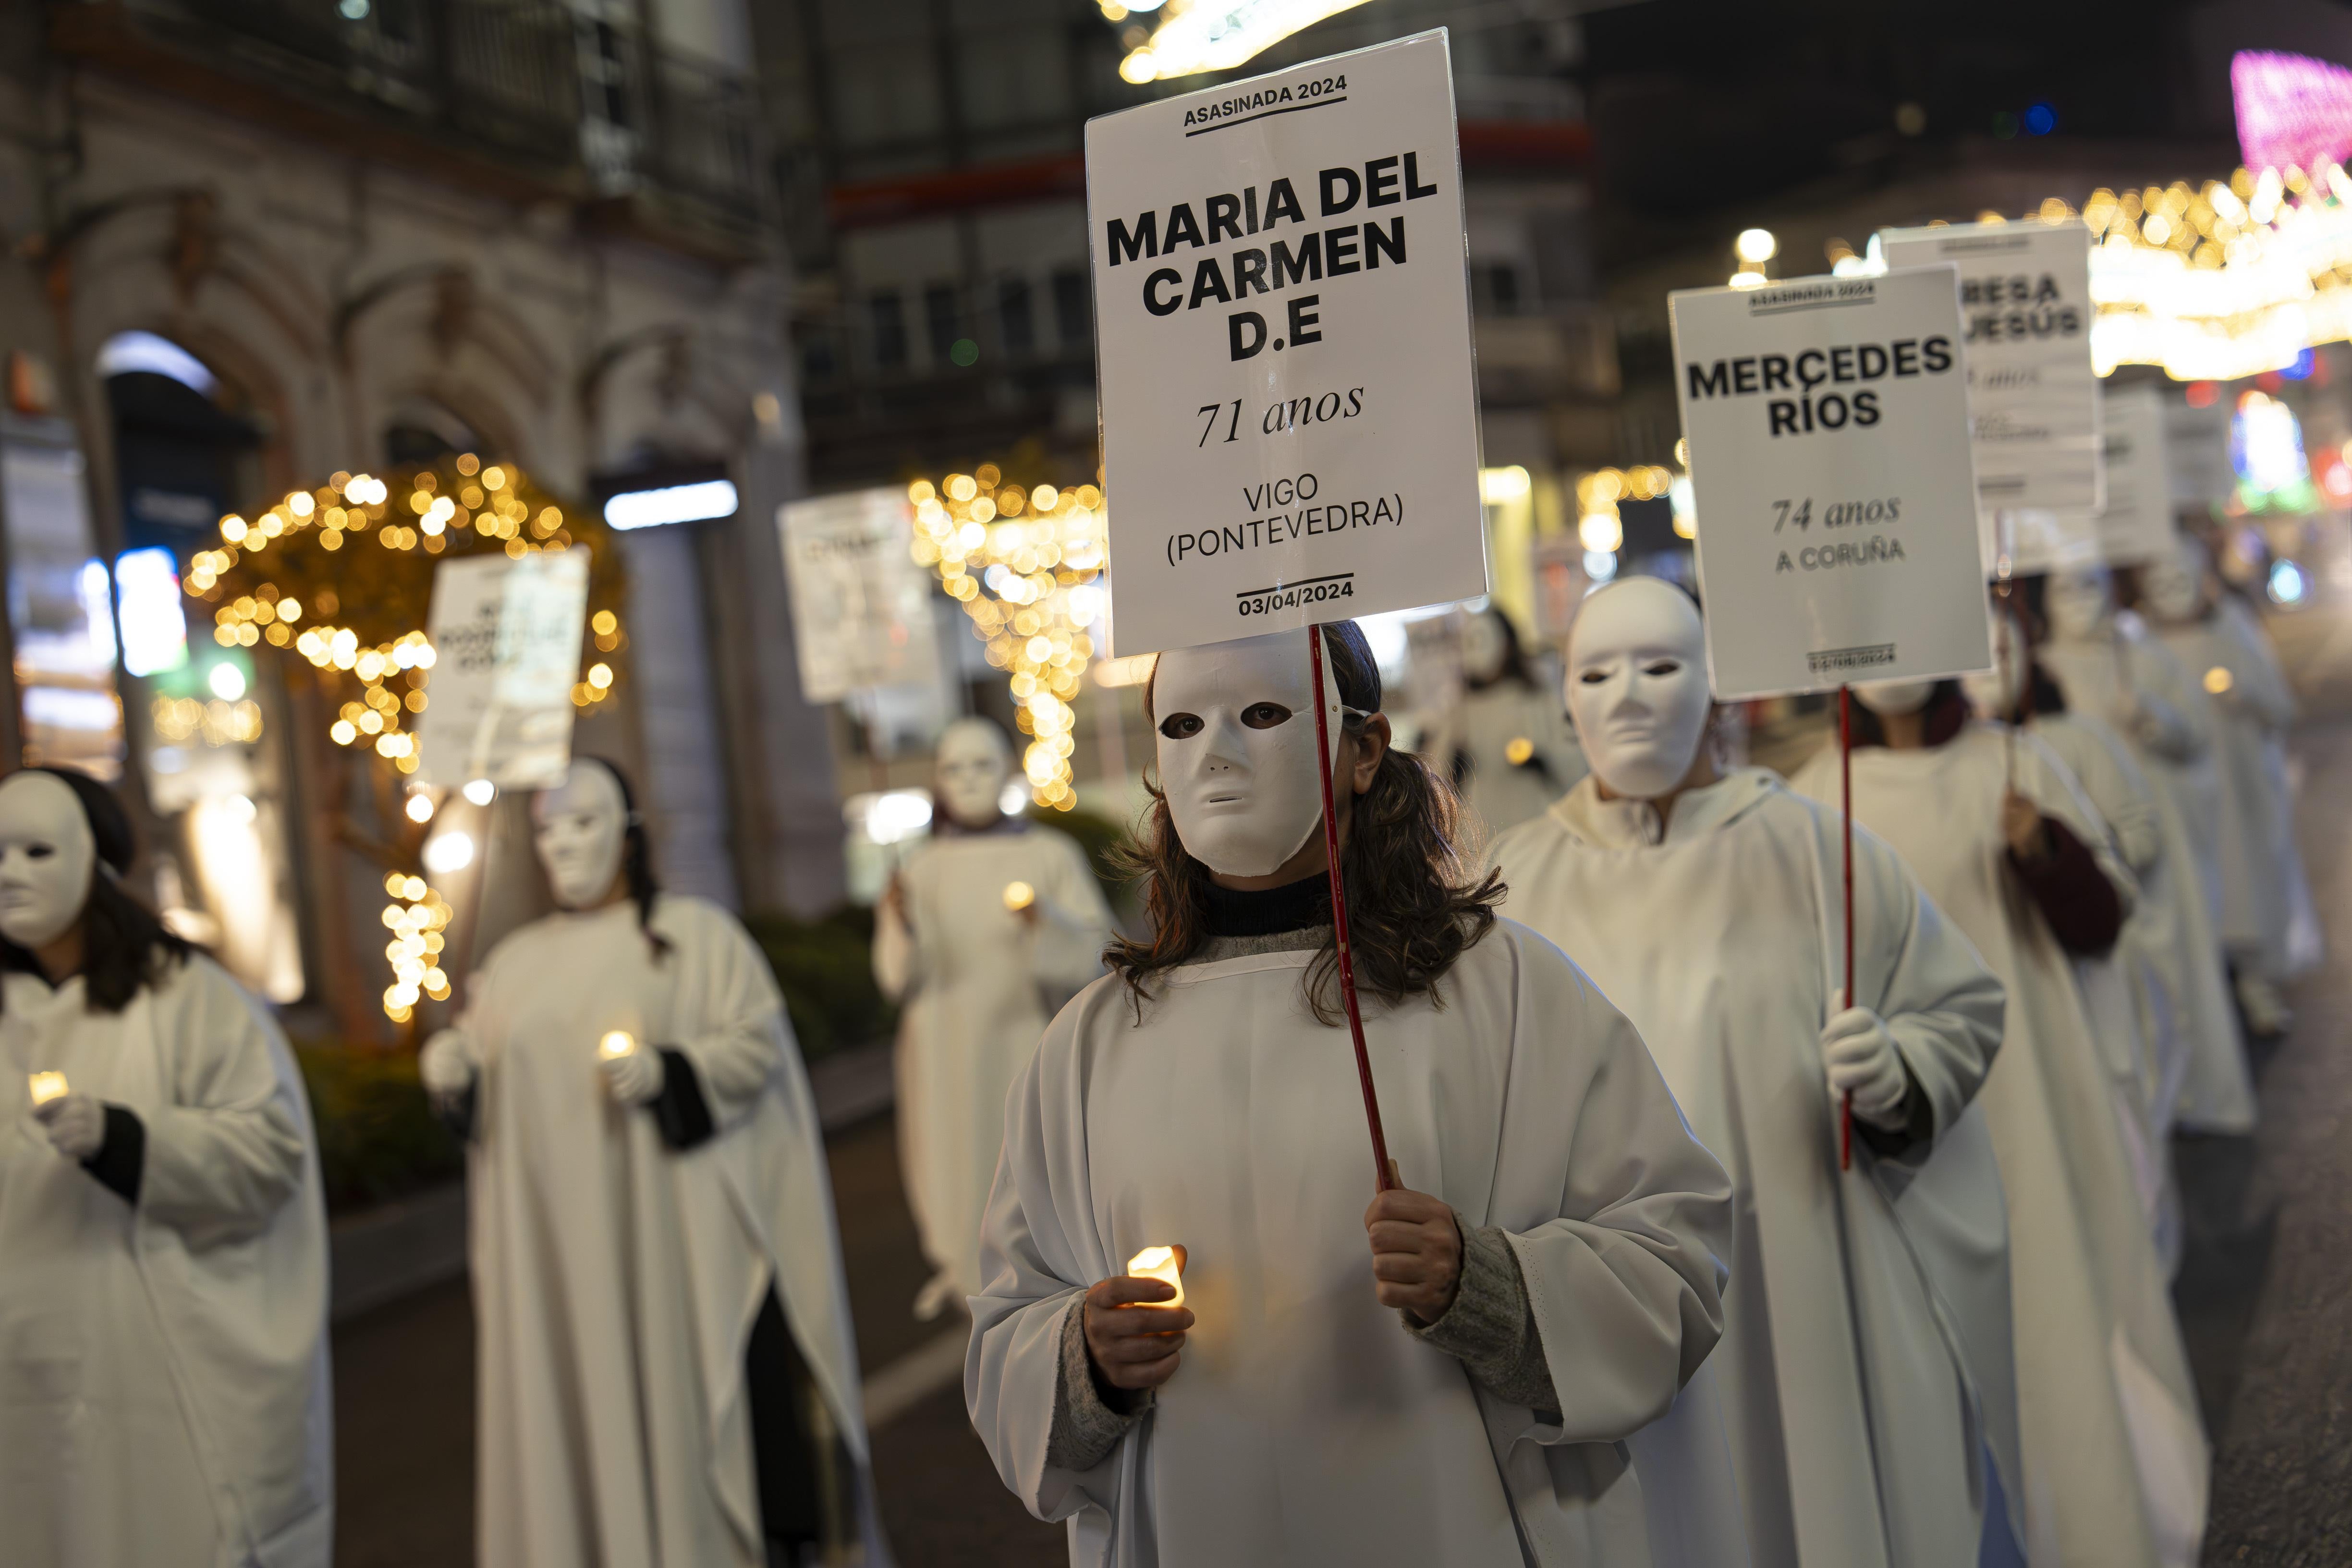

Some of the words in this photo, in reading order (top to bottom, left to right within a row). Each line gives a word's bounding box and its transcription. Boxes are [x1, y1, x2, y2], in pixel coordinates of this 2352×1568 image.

[1183, 87, 1292, 126] ASASINADA
[1298, 74, 1347, 100] 2024
[1107, 178, 1305, 267] MARIA
[1319, 151, 1437, 217] DEL
[1143, 216, 1406, 316] CARMEN
[1961, 272, 2060, 306] RESA
[1229, 294, 1322, 361] D.E
[1687, 335, 1952, 399] MERCEDES
[1197, 399, 1243, 448] 71
[1263, 387, 1364, 435] anos
[1769, 389, 1880, 437] RÍOS
[1243, 474, 1317, 511] VIGO
[1772, 497, 1813, 534] 74
[1825, 497, 1901, 528] anos
[1168, 493, 1404, 567] (PONTEVEDRA)
[1777, 550, 1794, 573] A
[1799, 535, 1905, 571] CORUÑA
[1239, 582, 1353, 616] 03/04/2024
